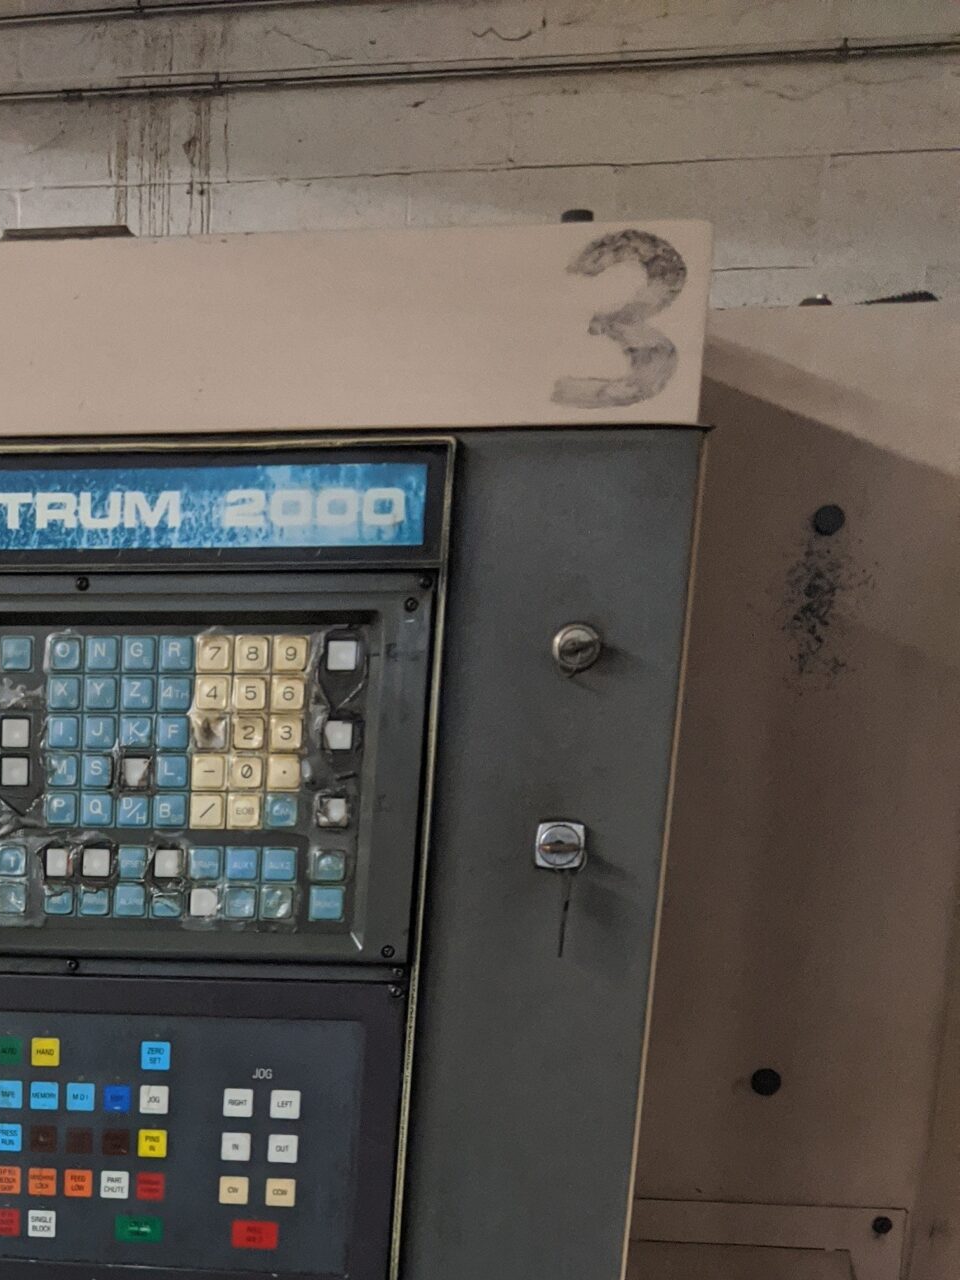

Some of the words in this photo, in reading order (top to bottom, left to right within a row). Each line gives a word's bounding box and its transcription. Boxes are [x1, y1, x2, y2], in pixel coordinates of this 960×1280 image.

[550, 229, 687, 409] 3
[223, 487, 405, 526] 2000
[94, 642, 106, 657] N
[130, 642, 144, 657] G
[168, 642, 181, 657] R
[209, 647, 221, 660] 7
[246, 647, 259, 661] 8
[285, 647, 297, 661] 9
[57, 682, 67, 696] X
[93, 682, 104, 696] Y
[130, 682, 141, 696] Z
[206, 685, 218, 700] 4
[245, 685, 257, 700] 5
[283, 686, 295, 700] 6
[91, 722, 103, 736] J
[129, 722, 141, 736] K
[168, 724, 179, 739] F
[242, 725, 255, 740] 2
[280, 725, 293, 740] 3
[90, 761, 103, 775] S
[164, 762, 175, 776] L
[53, 800, 65, 813] P
[90, 800, 103, 815] Q
[159, 803, 171, 818] B
[235, 807, 255, 815] EOB
[36, 1048, 55, 1056] HAND
[147, 1047, 165, 1055] ZERO
[252, 1068, 273, 1080] JOG
[147, 1096, 160, 1104] JOG
[228, 1099, 247, 1107] RIGHT
[276, 1100, 293, 1108] LEFT
[232, 1143, 239, 1151] IN
[275, 1145, 289, 1153] OUT
[103, 1186, 125, 1194] CHUTE
